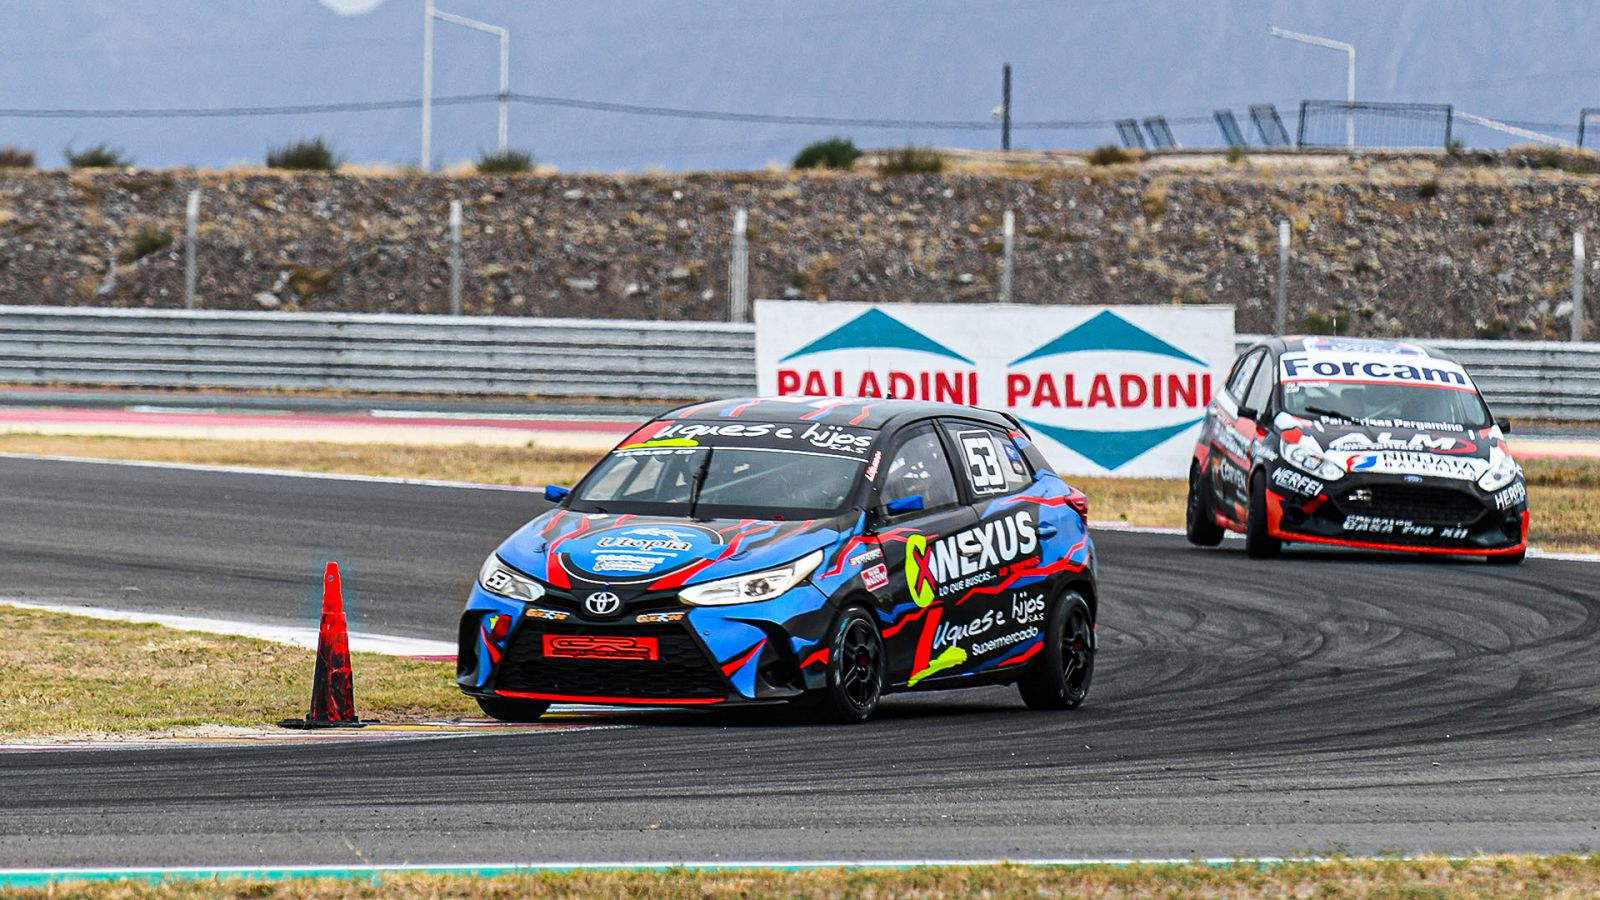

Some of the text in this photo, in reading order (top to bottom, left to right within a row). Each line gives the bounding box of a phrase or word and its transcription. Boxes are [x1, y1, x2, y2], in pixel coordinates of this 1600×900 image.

[777, 369, 978, 404] PALADINI
[1283, 358, 1466, 386] Forcam
[1007, 372, 1210, 408] PALADINI
[1394, 418, 1464, 432] Pergamino
[961, 437, 1005, 487] 53
[598, 537, 692, 550] Utopia
[934, 511, 1038, 583] NEXUS
[972, 626, 1039, 656] Supermercado
